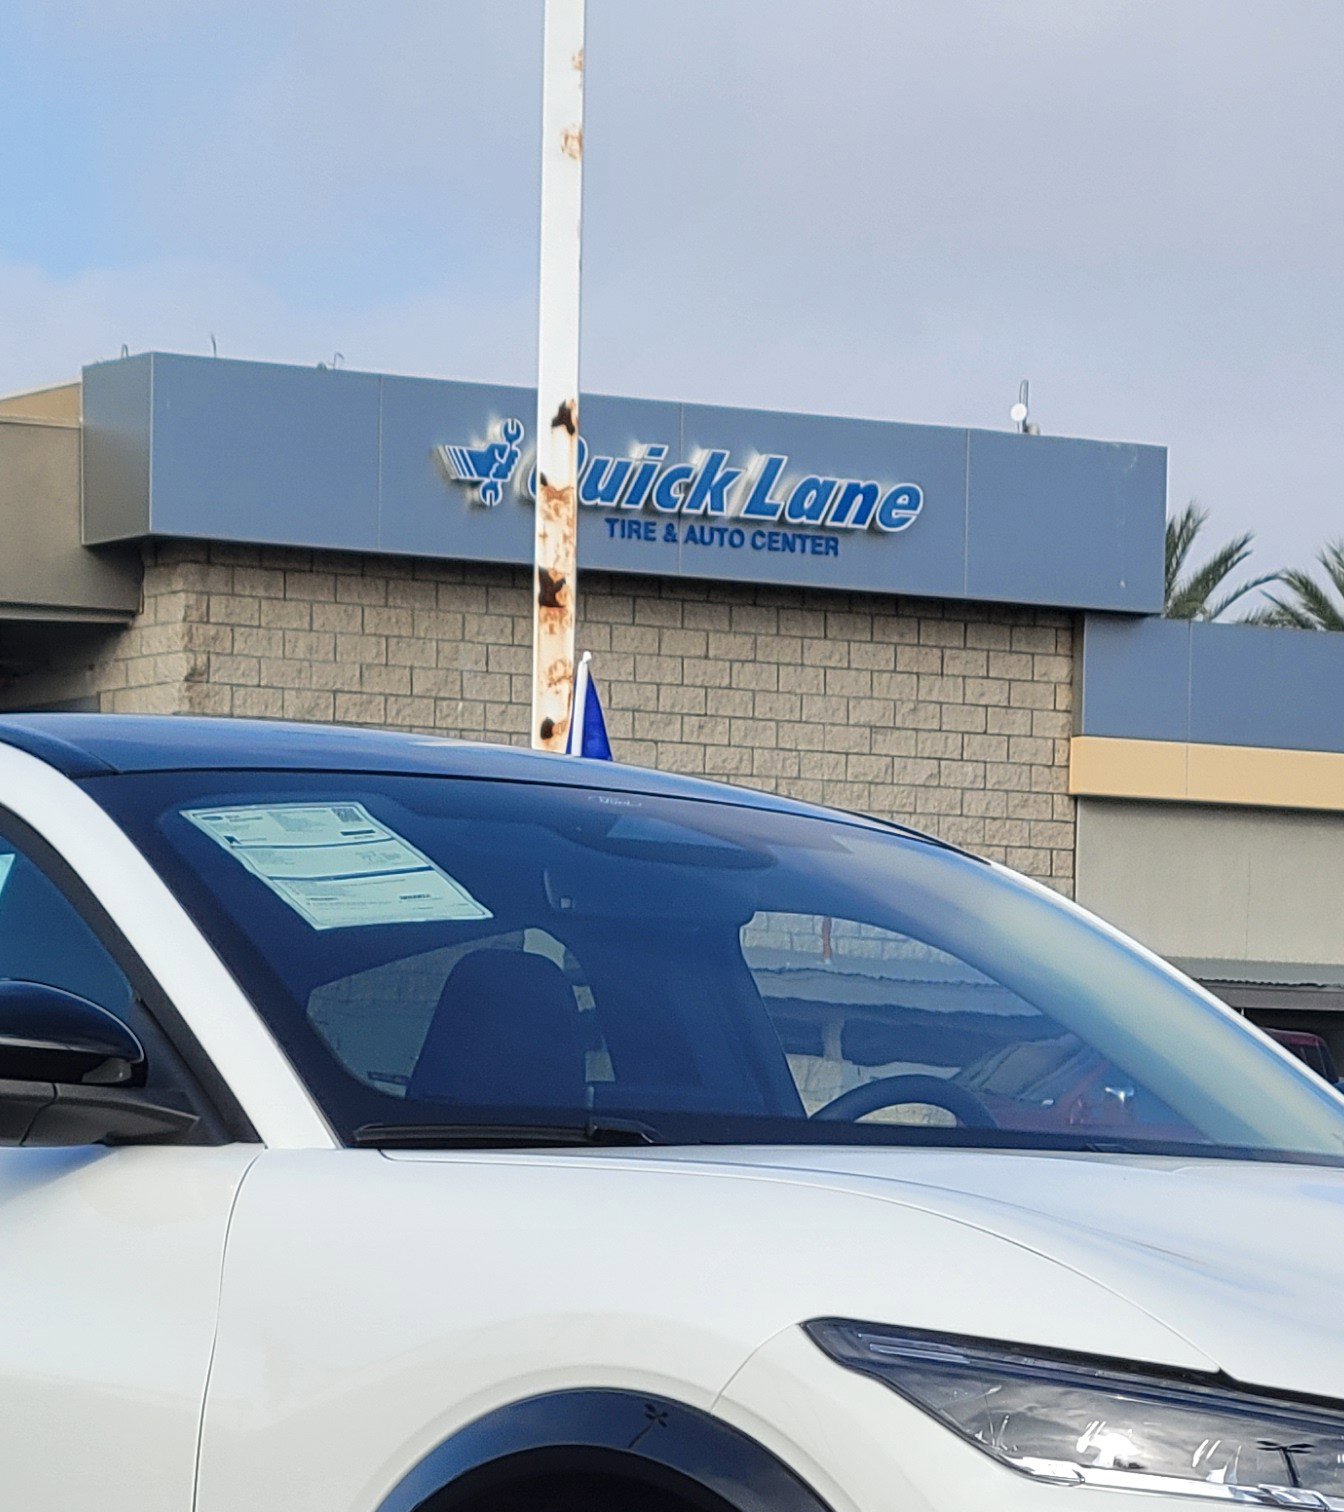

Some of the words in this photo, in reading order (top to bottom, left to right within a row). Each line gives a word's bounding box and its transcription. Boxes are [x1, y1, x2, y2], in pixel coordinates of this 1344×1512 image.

[740, 454, 924, 532] Lane
[604, 517, 657, 542] TIRE
[663, 522, 678, 544] &
[683, 524, 746, 549] AUTO
[750, 529, 840, 558] CENTER
